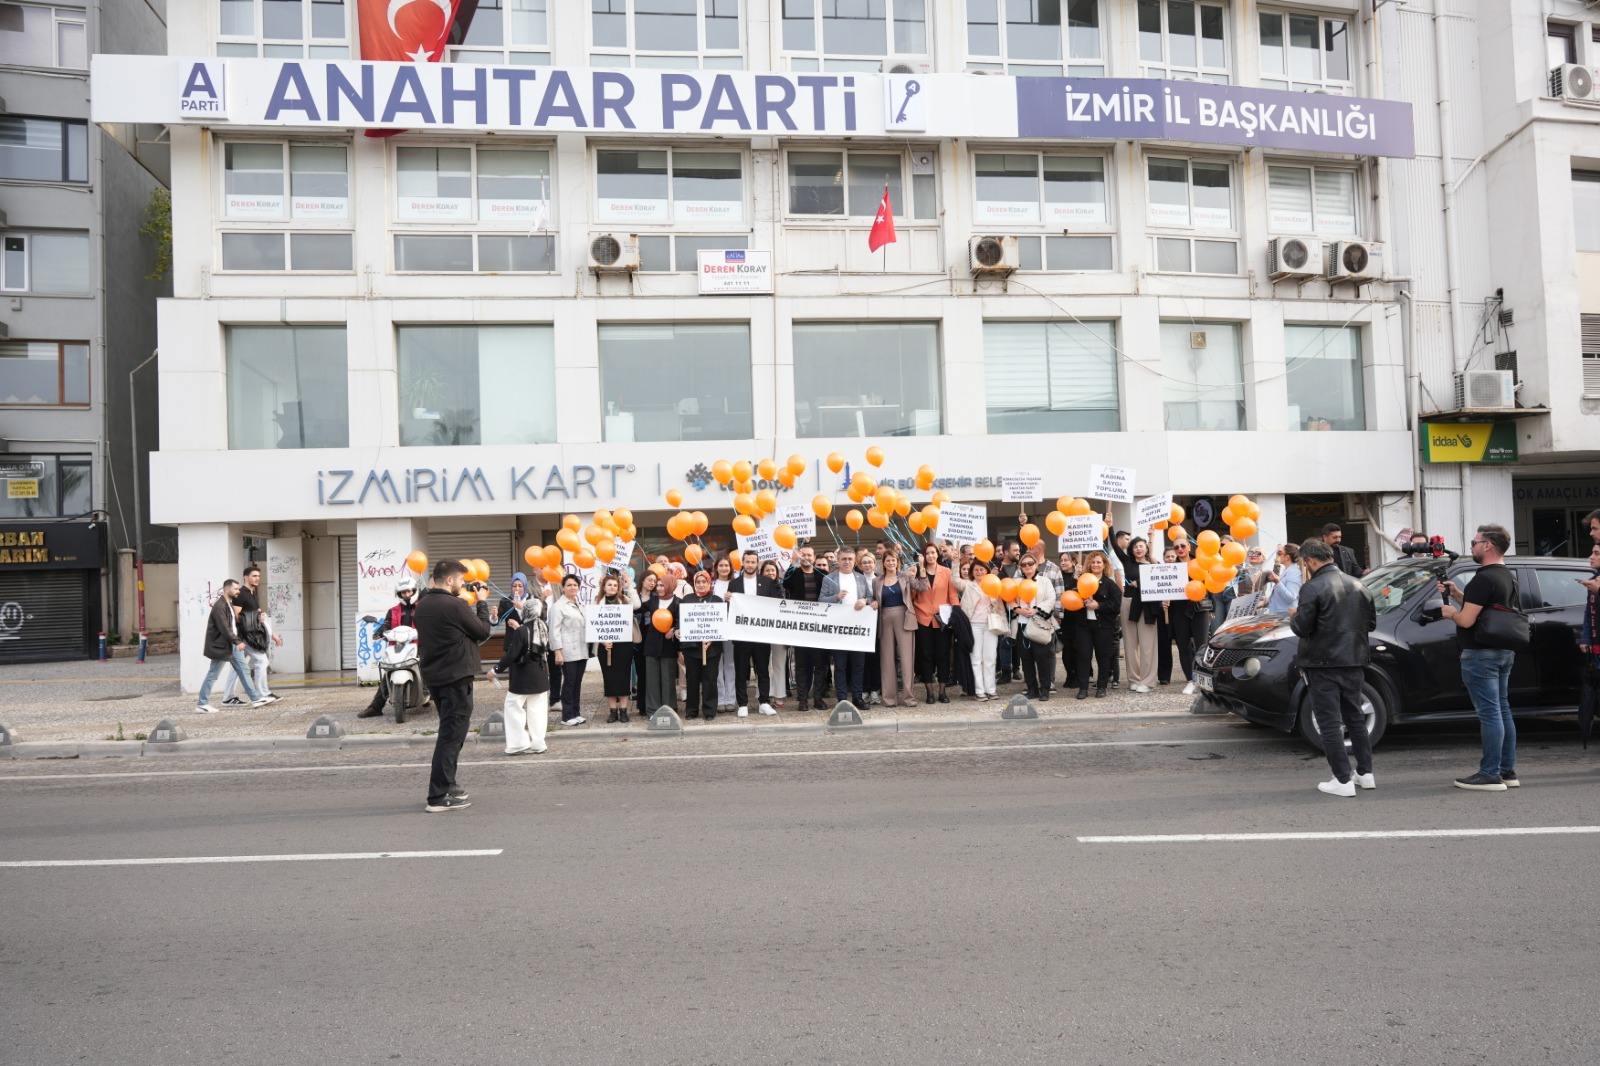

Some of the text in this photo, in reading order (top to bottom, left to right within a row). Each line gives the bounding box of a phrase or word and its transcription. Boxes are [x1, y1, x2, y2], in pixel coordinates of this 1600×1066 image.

[181, 62, 218, 98] A
[263, 62, 636, 129] ANAHTAR
[1065, 85, 1377, 141] İZMİR İL BAŞKANLIĞI
[704, 264, 767, 274] DEREN KORAY
[1432, 436, 1458, 446] iddaa
[1096, 486, 1127, 494] TOPLUMA
[1512, 488, 1532, 500] OK
[1537, 487, 1582, 502] AMAÇLI
[1138, 513, 1169, 526] TOLERANS
[736, 614, 749, 625] BİR
[750, 617, 775, 628] KADIN
[776, 620, 797, 630] DAHA
[799, 621, 866, 636] EKSİLMEYECEĞİZ
